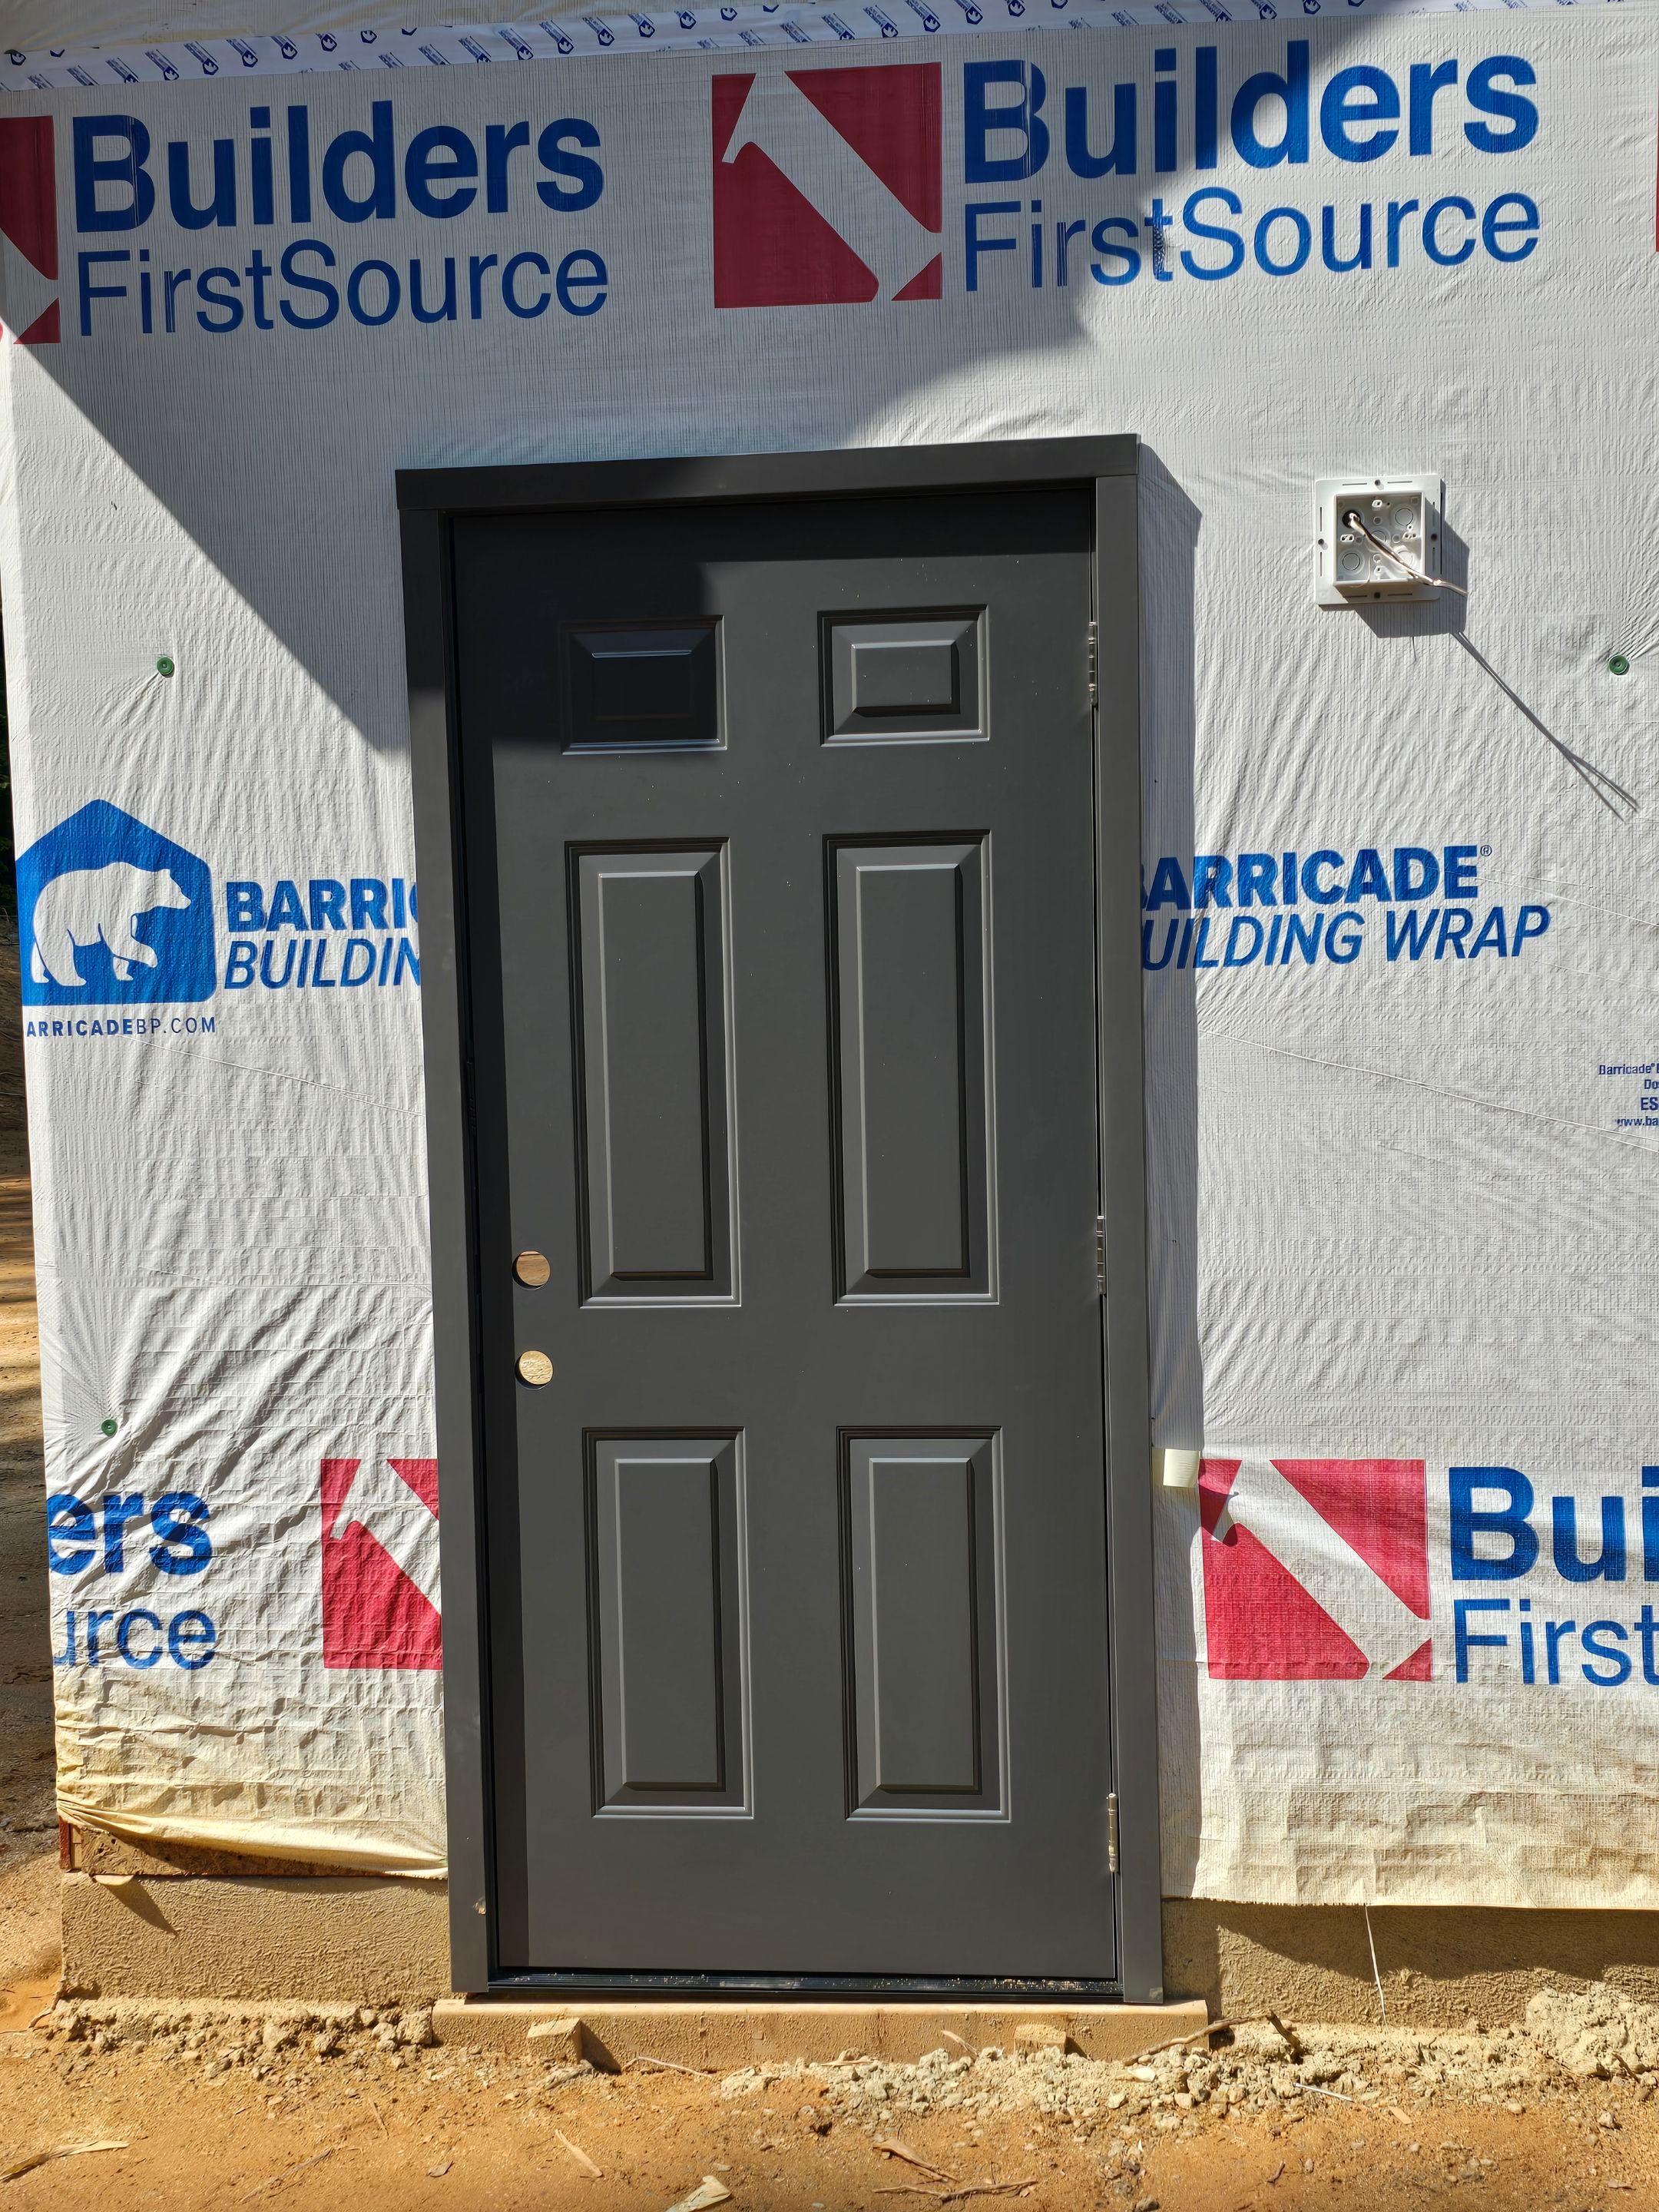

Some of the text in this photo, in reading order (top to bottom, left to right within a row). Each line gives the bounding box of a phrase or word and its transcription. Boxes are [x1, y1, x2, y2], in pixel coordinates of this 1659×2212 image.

[965, 38, 1539, 184] Builders
[73, 99, 604, 233] Builders
[965, 186, 1540, 292] FirstSource
[78, 240, 608, 336] FirstSource
[225, 878, 419, 932] BARRI
[1141, 844, 1492, 911] ARRICADE®
[1386, 905, 1551, 962] WRAP
[26, 1017, 216, 1037] ARRICADEBP.COM
